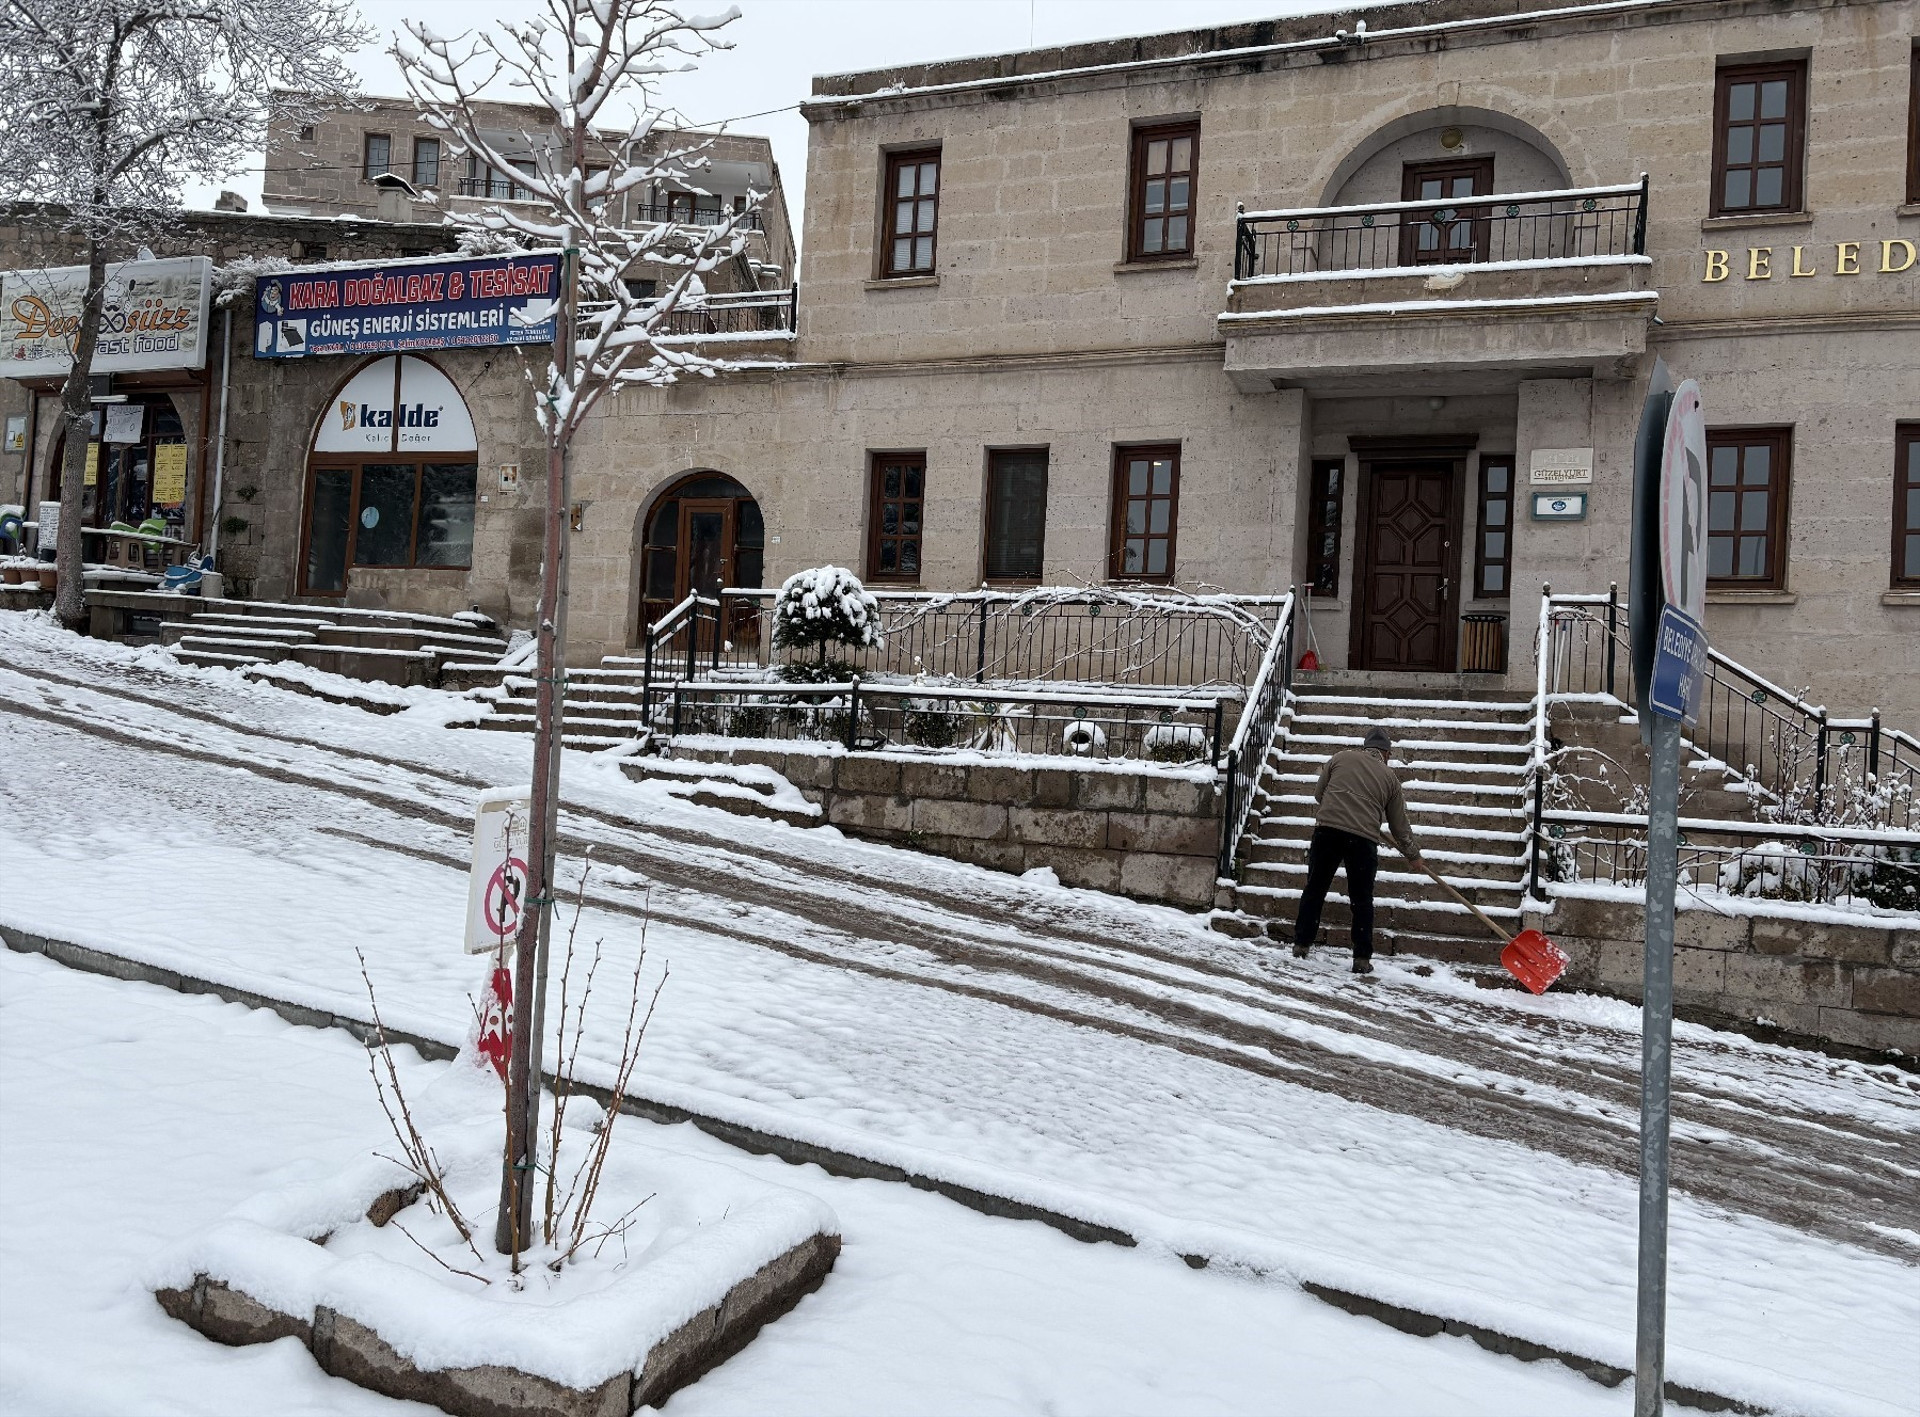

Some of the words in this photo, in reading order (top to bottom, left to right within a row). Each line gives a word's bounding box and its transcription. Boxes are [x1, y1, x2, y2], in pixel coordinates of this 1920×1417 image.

[1701, 239, 1917, 283] BELED
[289, 280, 340, 311] KARA
[343, 271, 445, 307] DOĞALGAZ
[448, 271, 465, 300] &
[469, 262, 554, 299] TESİSAT
[310, 313, 359, 340] GÜNEŞ
[362, 308, 413, 335] ENERJİ
[415, 302, 504, 332] SİSTEMLERİ
[133, 332, 180, 354] food
[360, 403, 439, 428] kalde
[1534, 468, 1588, 477] GÜZELYURT
[1662, 625, 1693, 664] BELEDİYE
